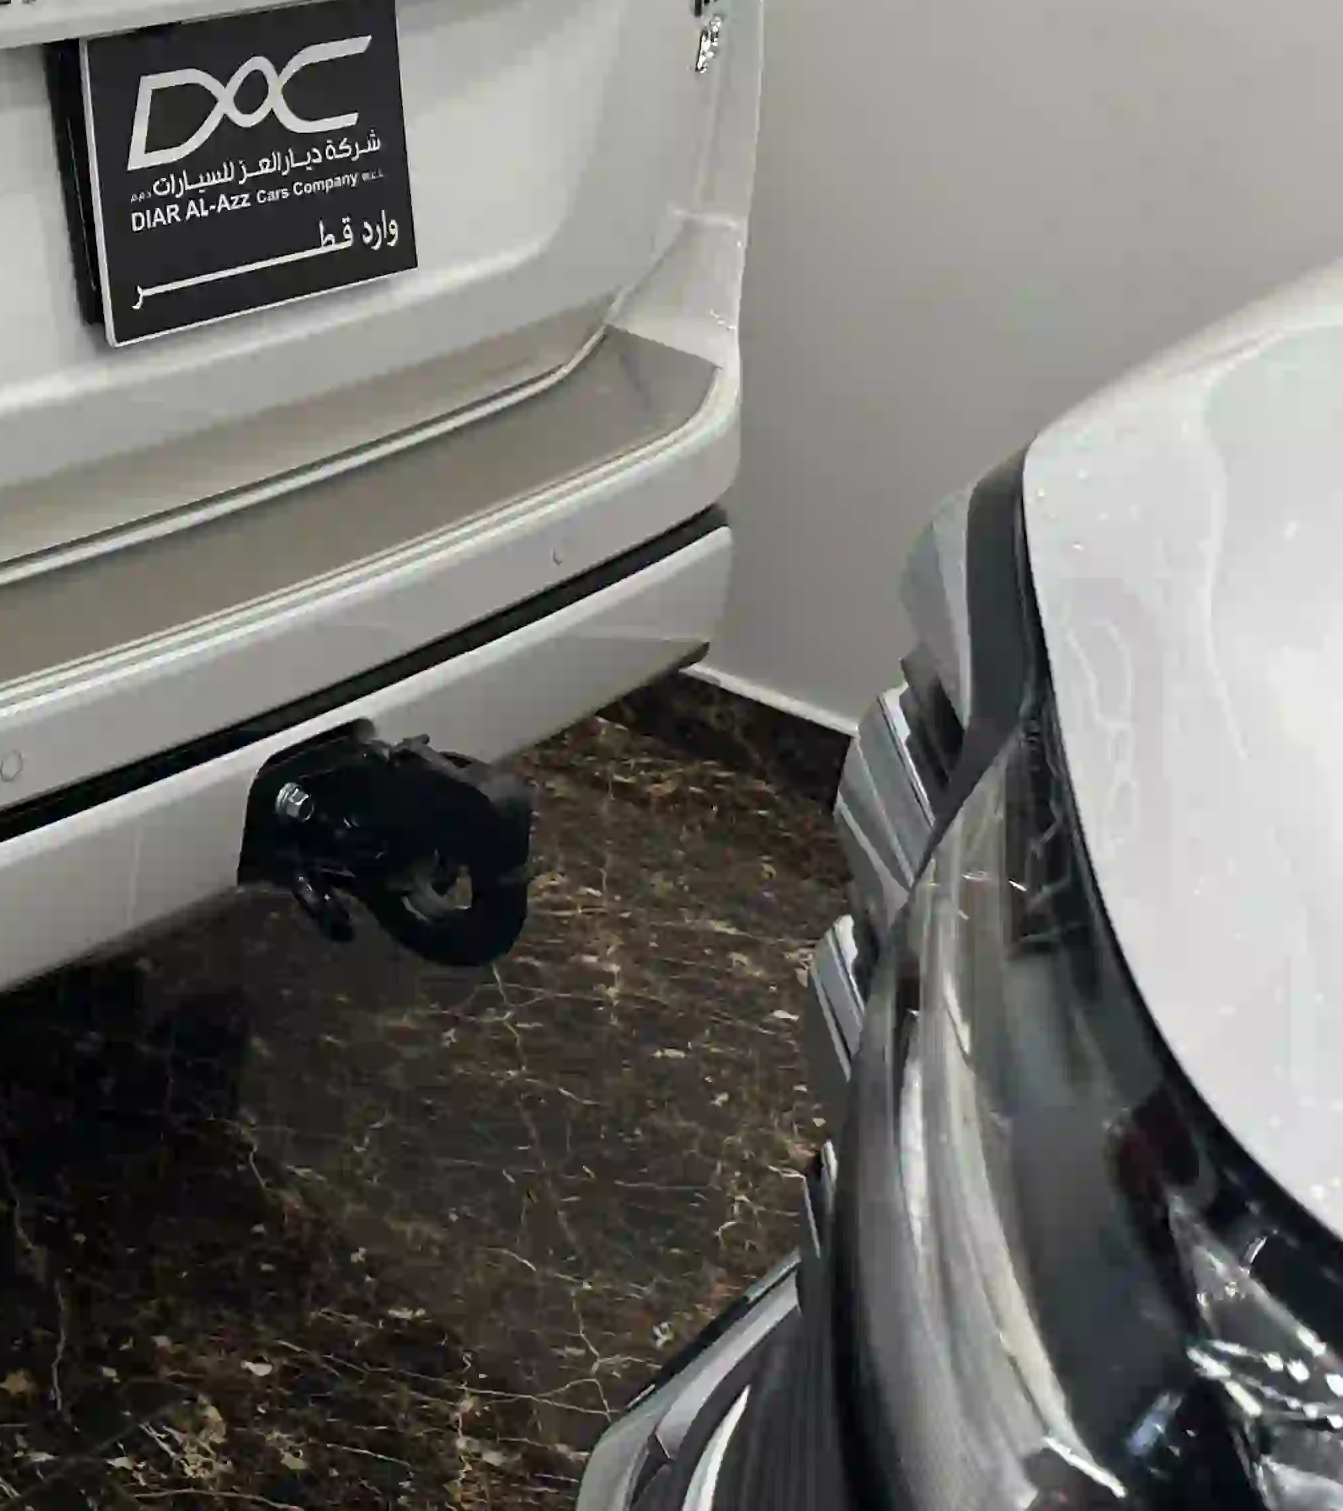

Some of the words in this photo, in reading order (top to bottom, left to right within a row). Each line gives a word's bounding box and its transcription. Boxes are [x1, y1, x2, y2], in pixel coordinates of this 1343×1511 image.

[280, 147, 323, 176] ديار
[325, 129, 382, 162] شركة
[152, 160, 235, 199] للسيارات
[131, 203, 182, 232] DIAR
[185, 193, 252, 222] AL-Azz
[256, 188, 291, 204] Cars
[293, 172, 359, 196] Company
[362, 209, 399, 250] وارد
